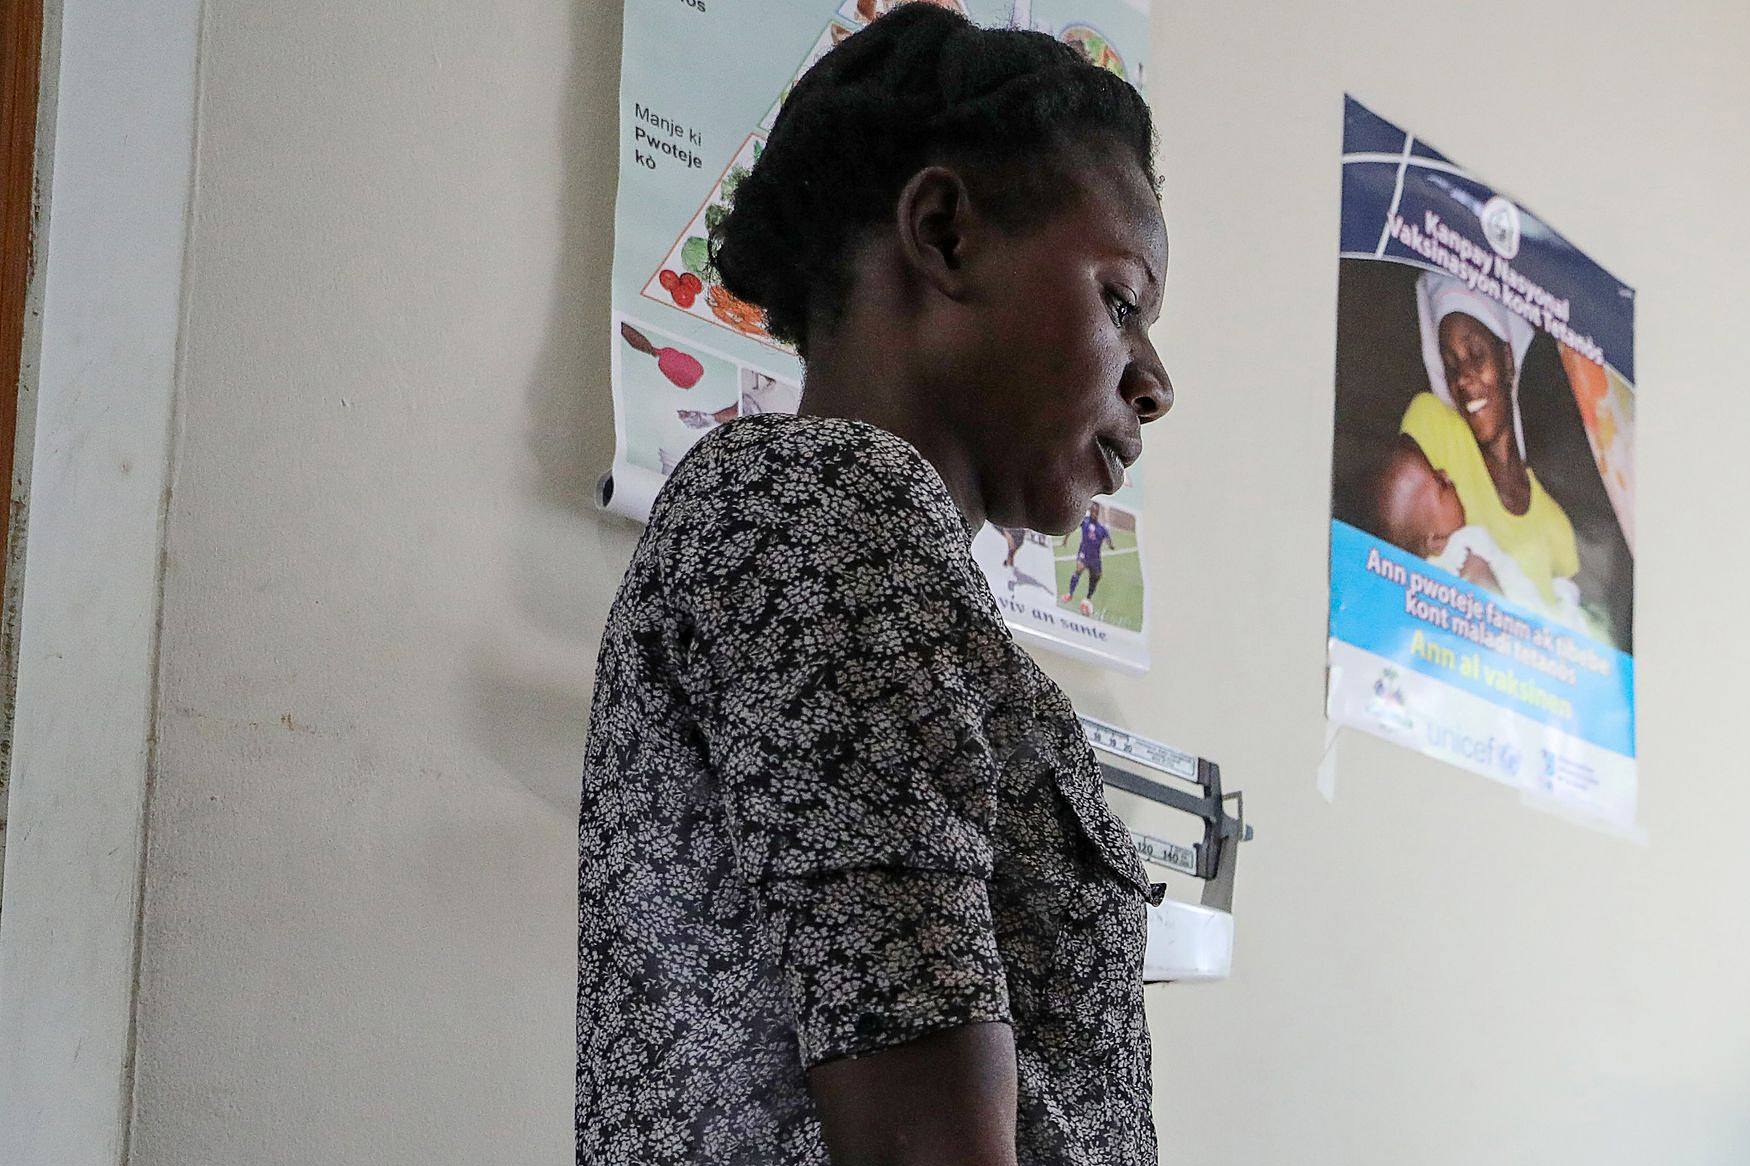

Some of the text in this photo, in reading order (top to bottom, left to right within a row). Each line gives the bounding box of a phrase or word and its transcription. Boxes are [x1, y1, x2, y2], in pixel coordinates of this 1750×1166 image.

[635, 103, 702, 147] Manje ki
[635, 126, 702, 169] Pwoteje
[635, 149, 656, 170] kò
[1366, 547, 1407, 586] Ann
[1410, 572, 1484, 620] pwoteje
[1032, 608, 1054, 624] an
[1405, 590, 1449, 628] kont
[1411, 629, 1456, 671] Ann
[1459, 652, 1480, 681] al
